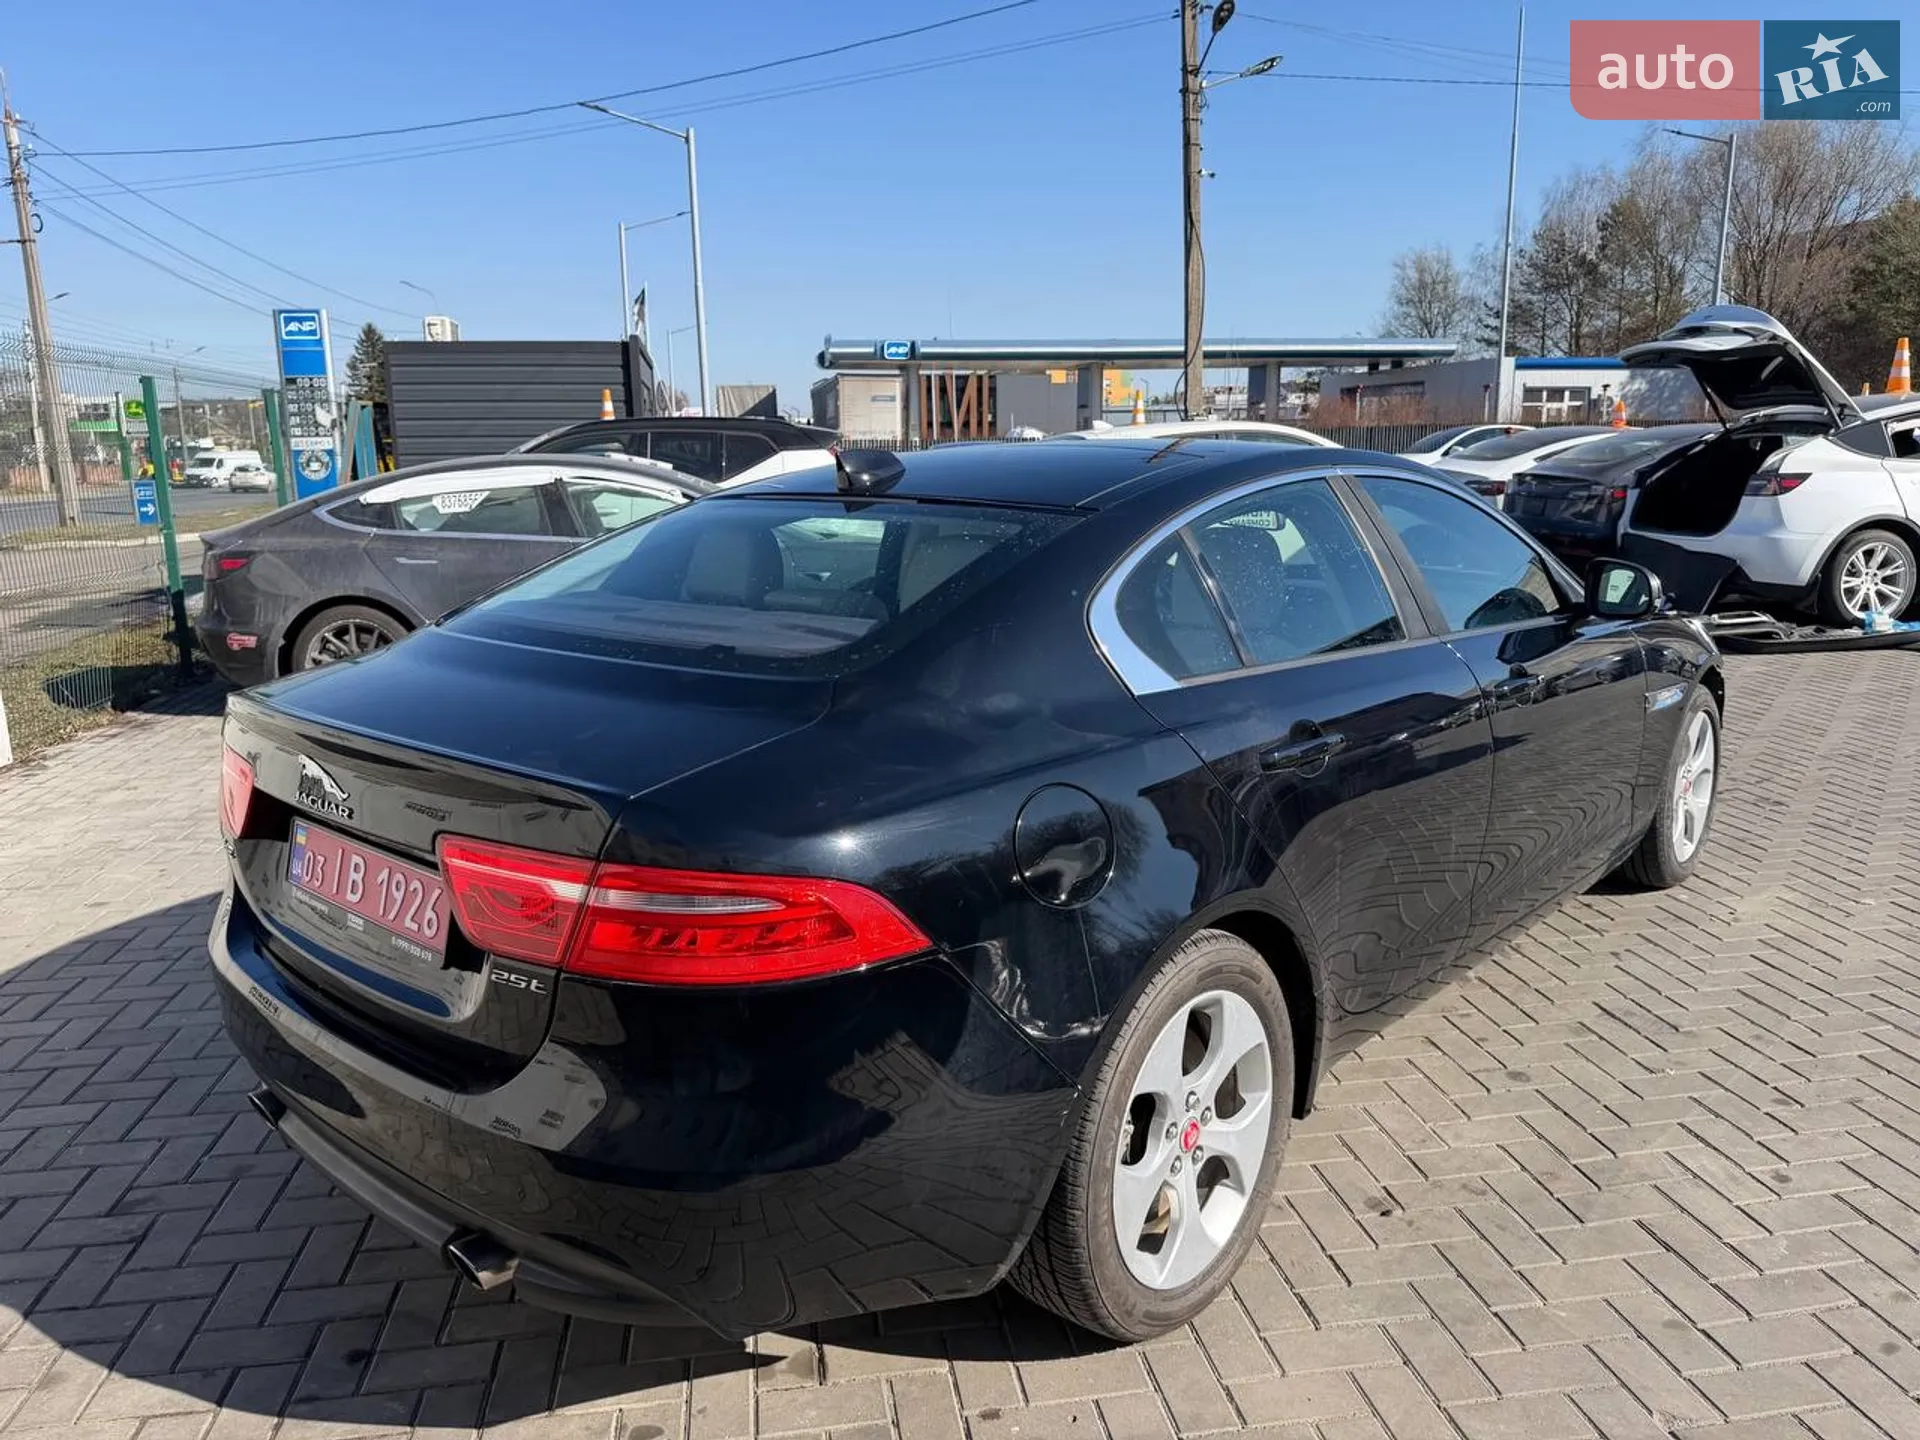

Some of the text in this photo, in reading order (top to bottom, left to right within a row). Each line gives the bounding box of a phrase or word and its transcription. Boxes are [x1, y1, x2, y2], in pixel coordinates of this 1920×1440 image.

[293, 791, 350, 819] JAGUAR
[303, 851, 325, 888] 03
[376, 867, 445, 940] 1926
